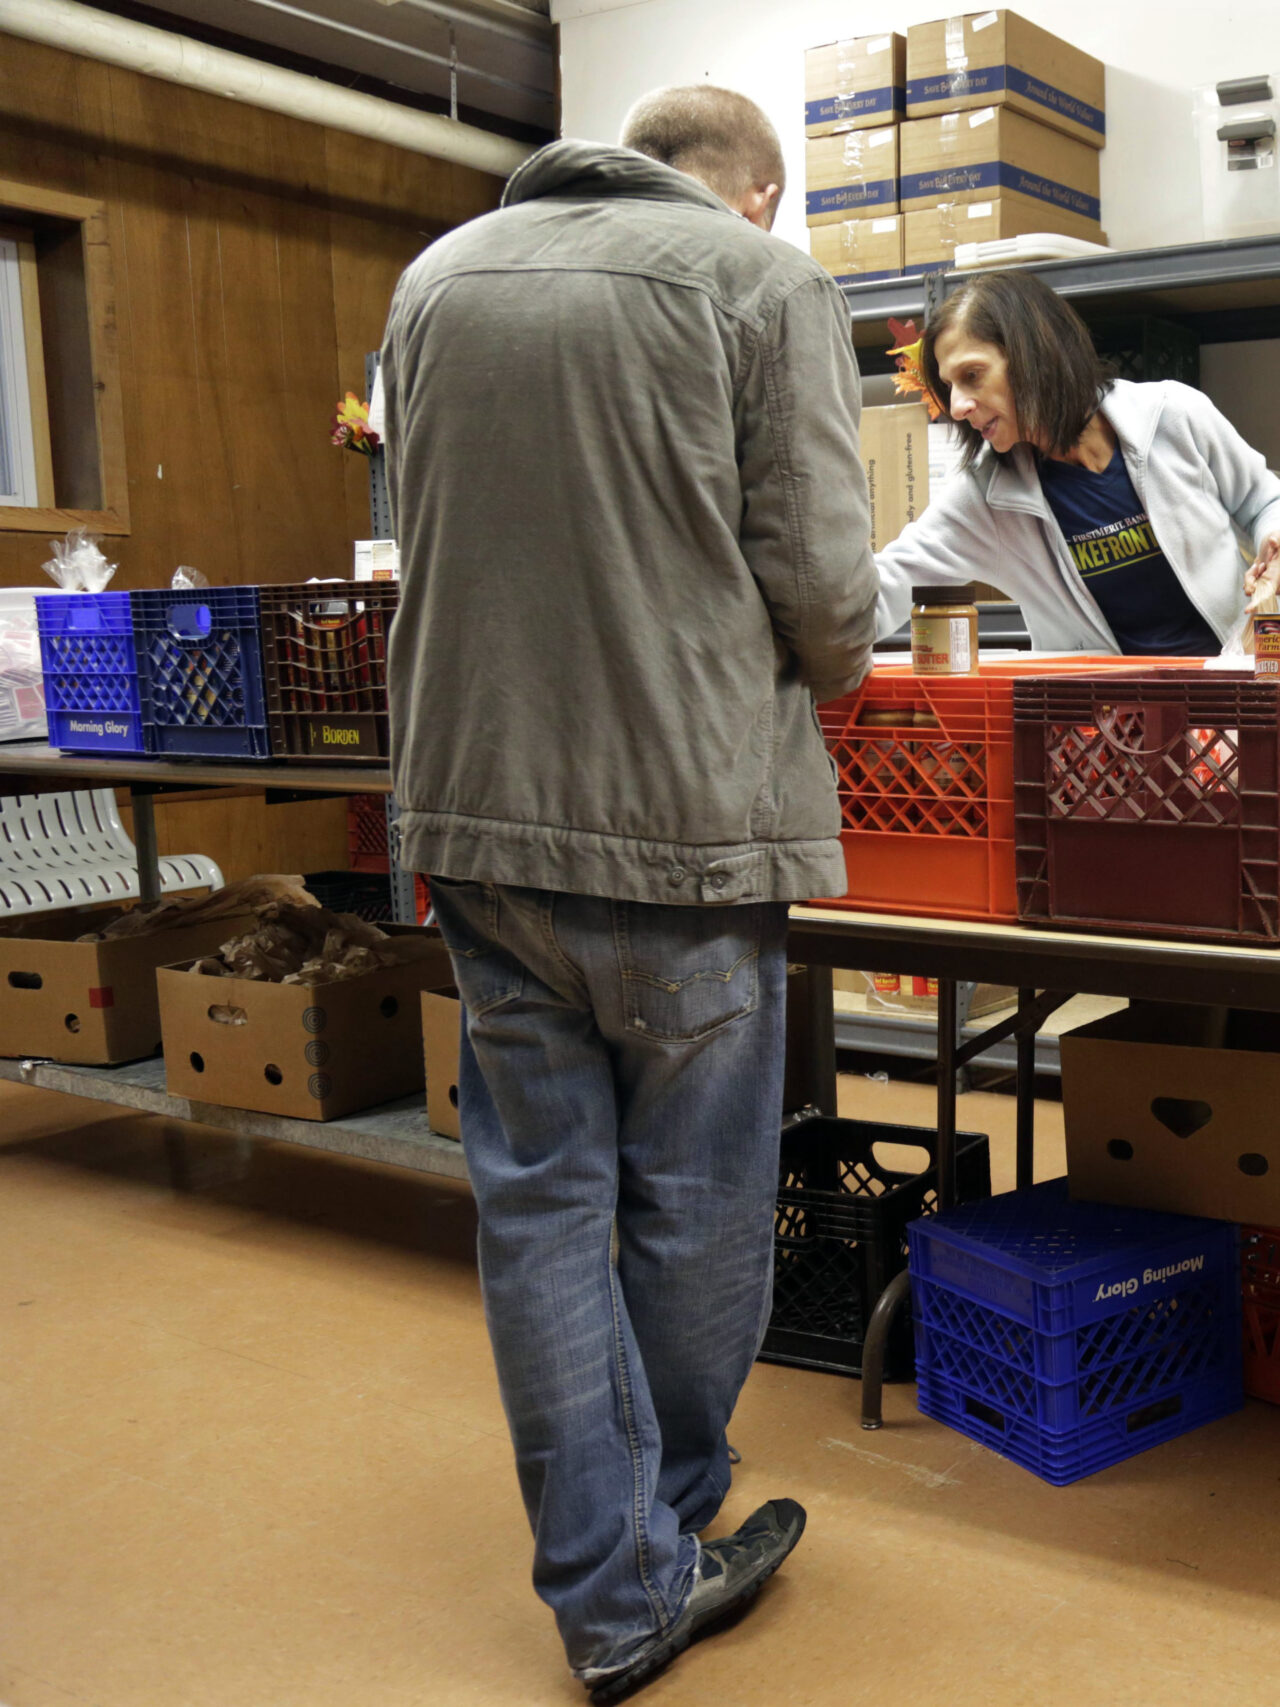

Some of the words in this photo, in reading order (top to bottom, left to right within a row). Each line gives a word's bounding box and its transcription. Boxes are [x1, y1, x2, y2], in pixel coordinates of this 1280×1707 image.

[904, 432, 915, 482] gluten-free
[867, 458, 876, 500] anything
[906, 484, 914, 502] and
[1068, 522, 1160, 571] AKEFRONT
[917, 653, 949, 665] BUTTER
[70, 720, 104, 737] Morning
[105, 720, 129, 738] Glory
[1143, 1254, 1205, 1285] Morning
[1094, 1278, 1139, 1302] Glory
